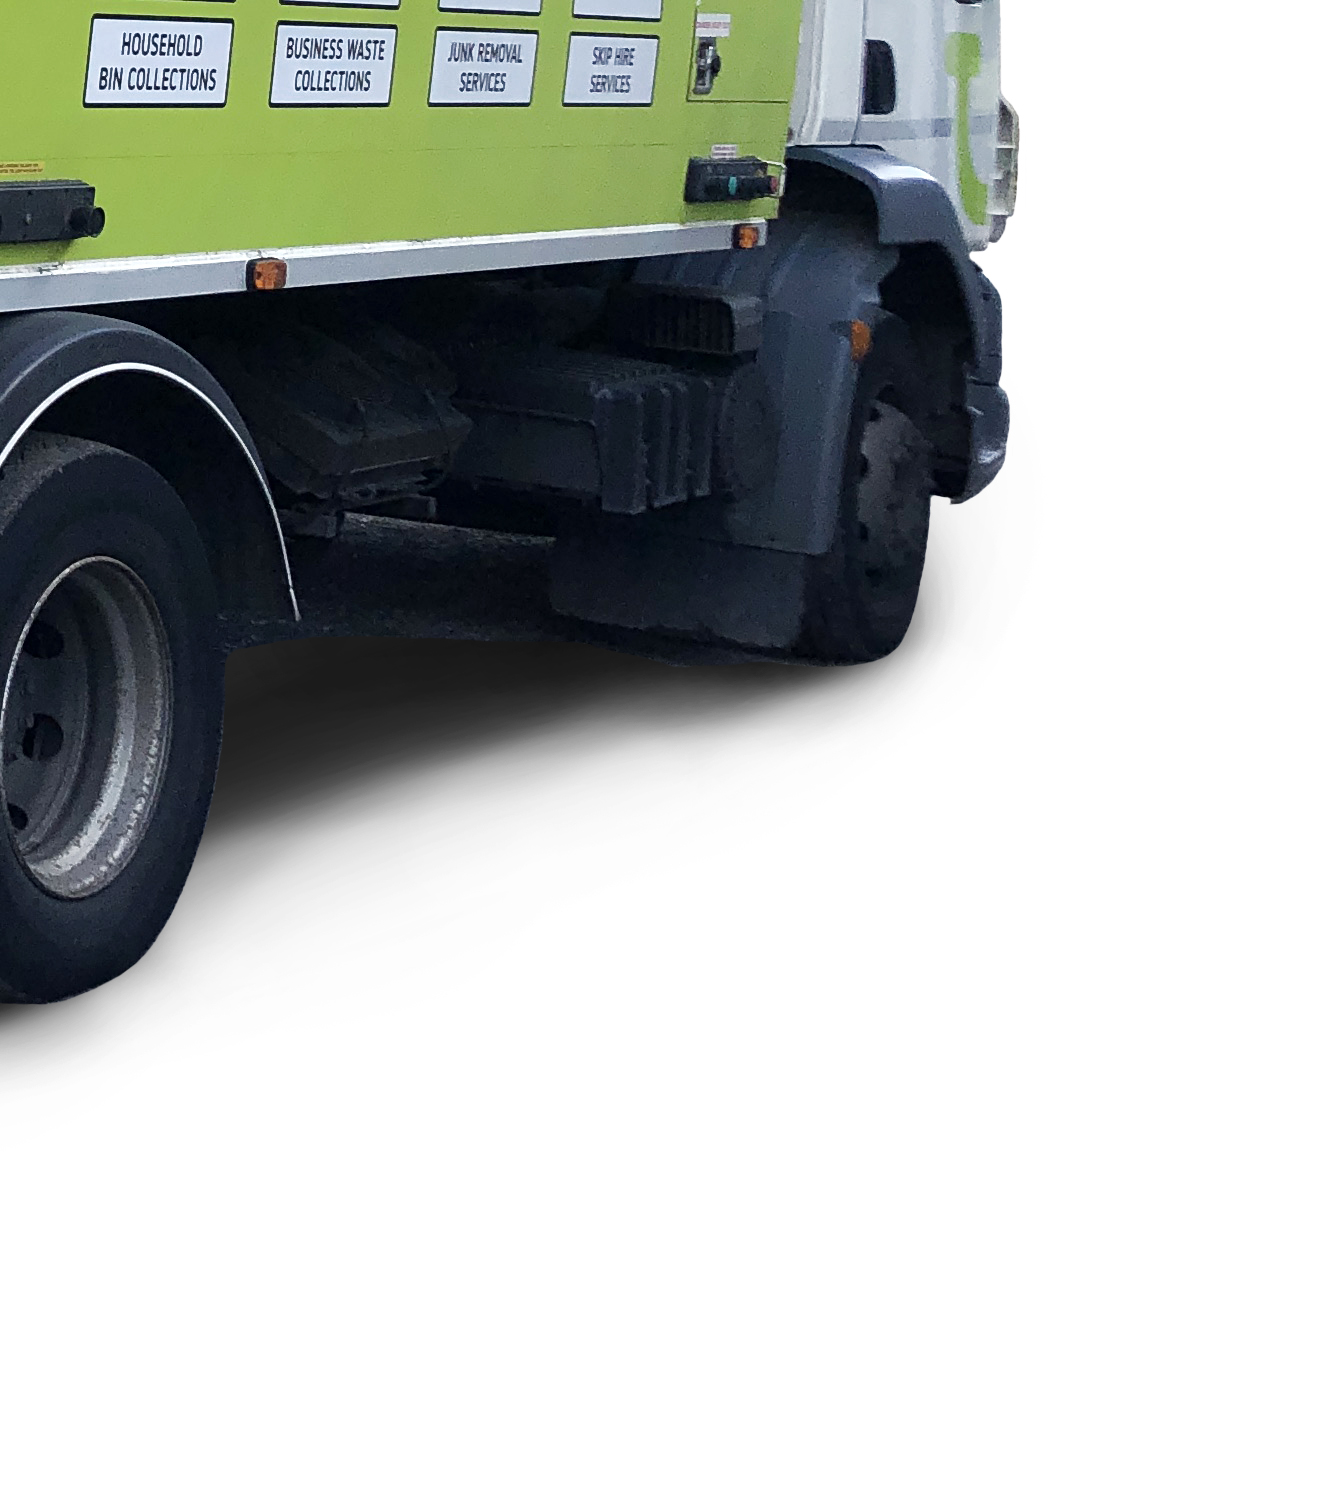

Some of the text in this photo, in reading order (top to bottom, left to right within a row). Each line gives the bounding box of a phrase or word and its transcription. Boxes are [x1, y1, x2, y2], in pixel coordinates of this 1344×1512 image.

[121, 32, 203, 57] HOUSEHOLD
[286, 37, 386, 60] BUSINESS WASTE
[448, 41, 523, 64] JUNK REMOVAL
[592, 46, 636, 66] SKIP HIRE
[98, 67, 217, 91] BIN COLLECTIONS
[294, 70, 372, 92] COLLECTIONS
[459, 72, 507, 92] SERVICES
[589, 74, 632, 94] SERVICES
